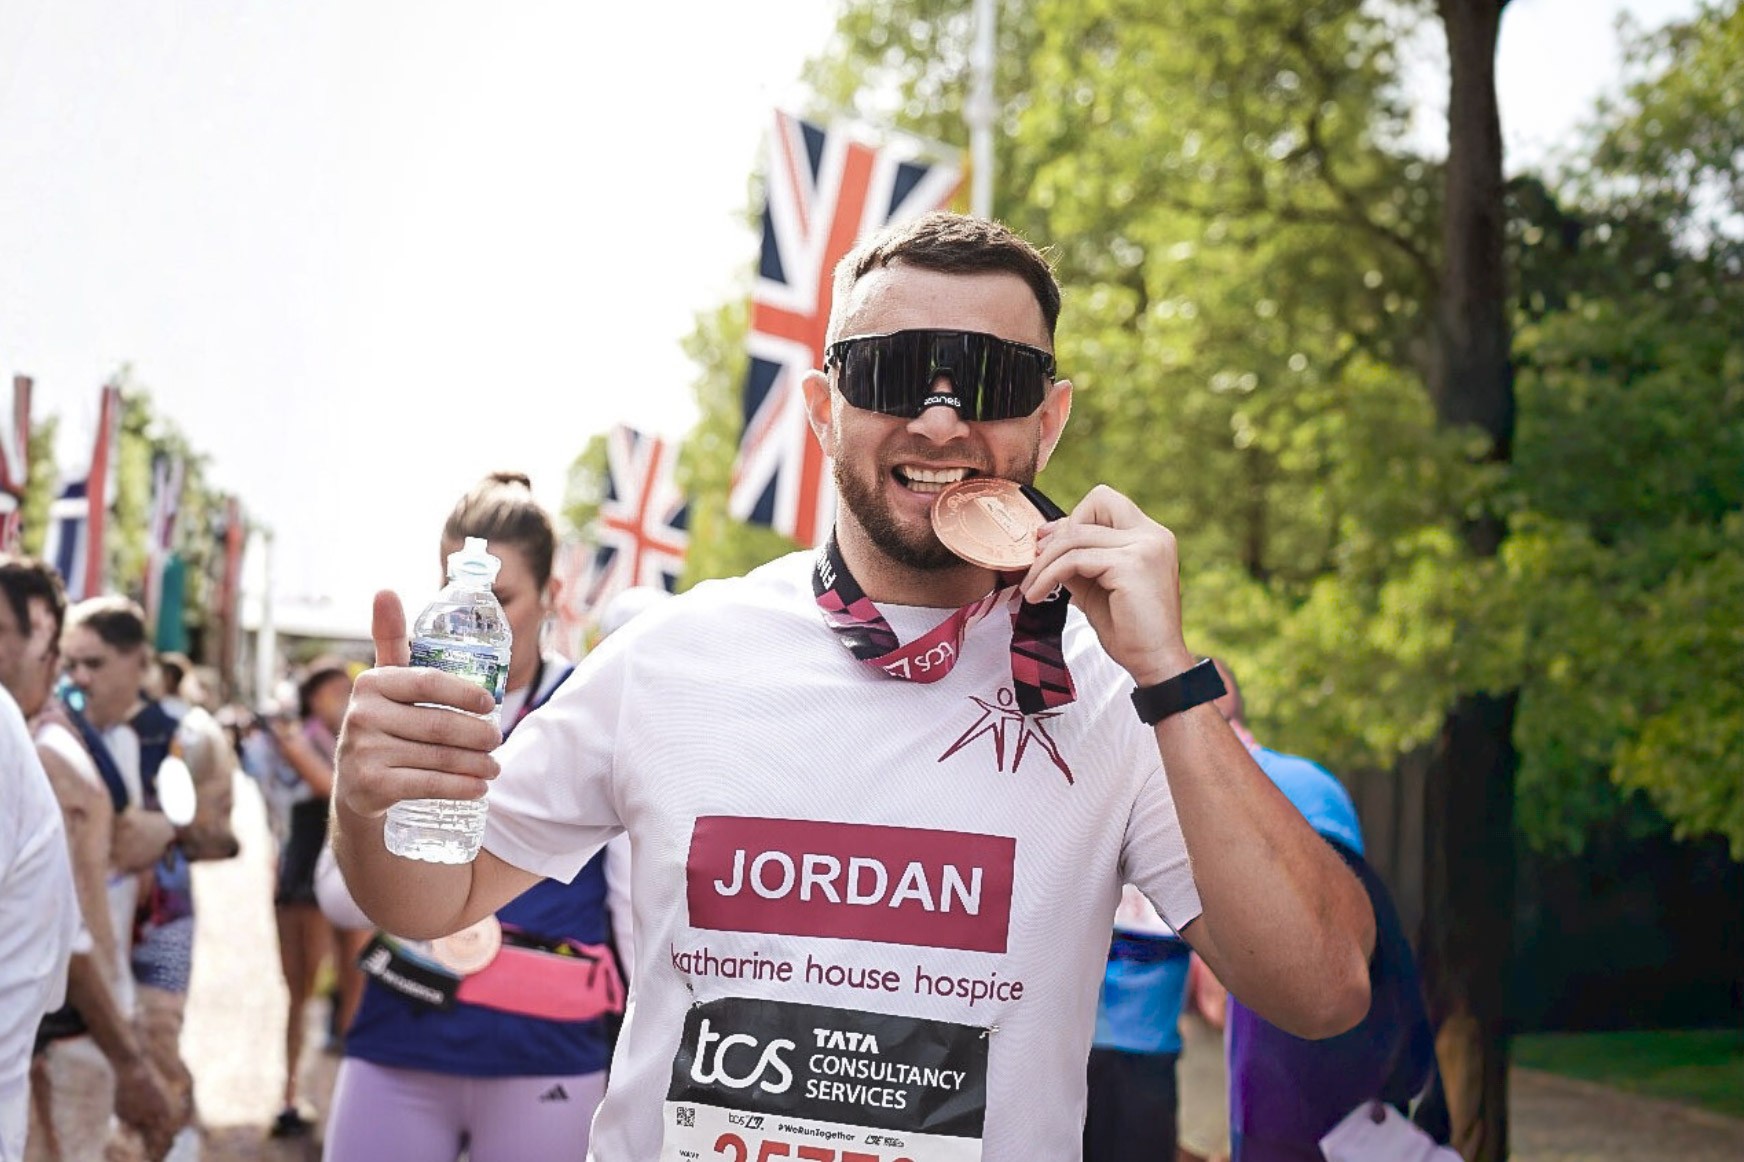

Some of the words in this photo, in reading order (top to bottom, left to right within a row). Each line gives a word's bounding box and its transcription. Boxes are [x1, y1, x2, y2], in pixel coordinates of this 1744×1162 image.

[713, 849, 983, 916] JORDAN
[671, 942, 793, 982] katharine
[805, 954, 900, 992] house
[914, 965, 1024, 1007] hospice
[690, 1018, 796, 1094] tcs
[812, 1027, 880, 1055] TATA
[804, 1079, 907, 1110] SERVICES
[808, 1054, 967, 1092] CONSULTANCY
